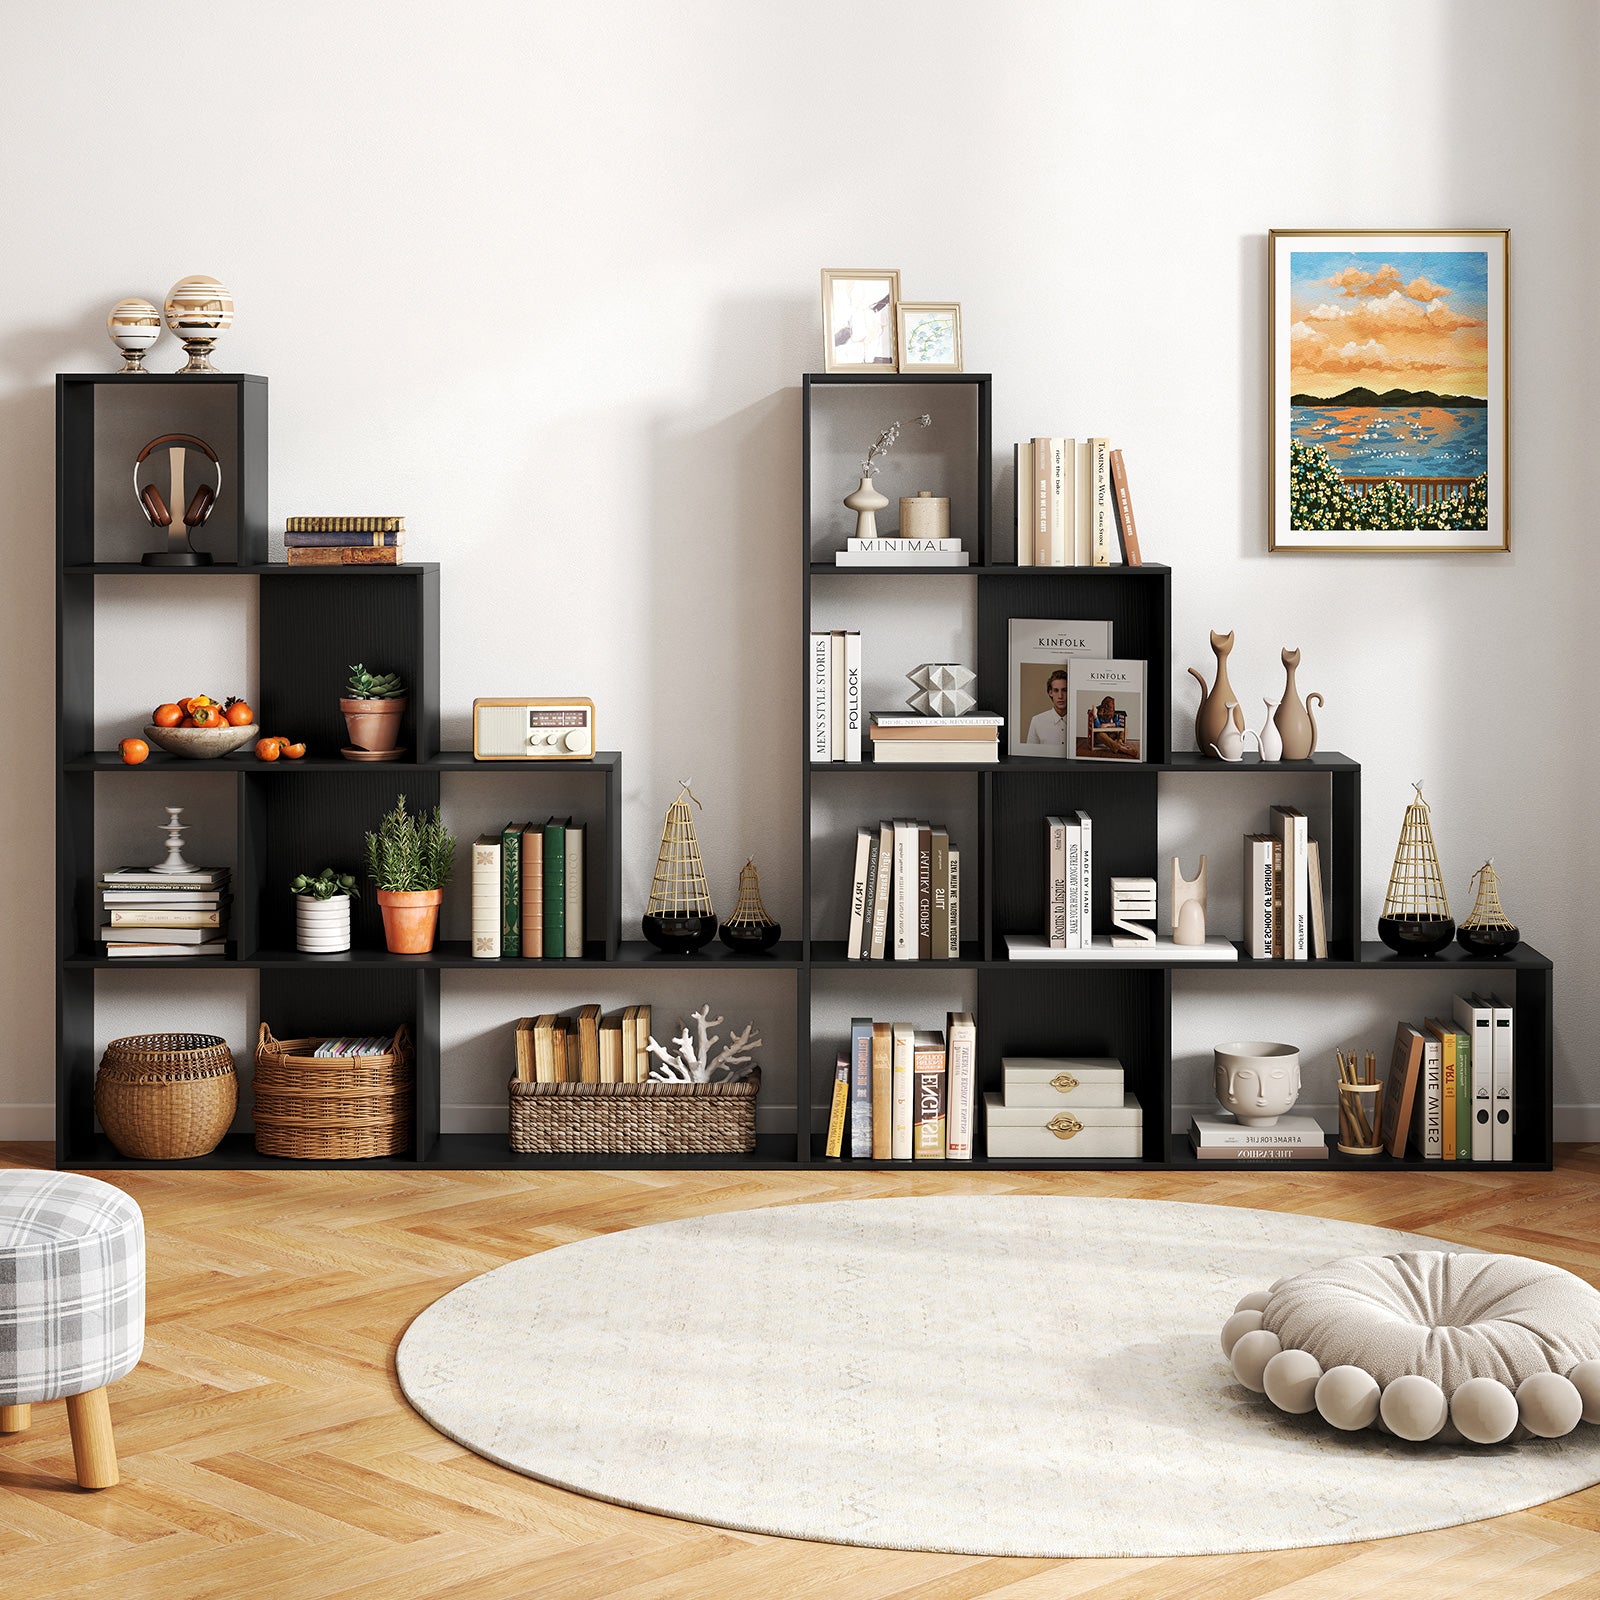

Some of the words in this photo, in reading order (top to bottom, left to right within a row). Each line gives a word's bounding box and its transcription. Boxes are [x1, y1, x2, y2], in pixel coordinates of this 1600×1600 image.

[860, 540, 948, 551] MINIMAL
[1039, 638, 1086, 647] KINFOLK
[816, 640, 826, 685] STORIES
[816, 687, 826, 720] STYLE
[850, 668, 858, 730] POLLOCK
[816, 720, 826, 753] MEN'S
[1070, 844, 1078, 866] FRIENDS
[1070, 866, 1078, 886] AMONG
[1084, 878, 1089, 888] BY
[1051, 879, 1065, 904] Inspire
[1070, 887, 1078, 903] HOME
[1070, 903, 1078, 919] YOUR
[1052, 915, 1064, 940] Rooms
[1070, 920, 1078, 934] MAKE
